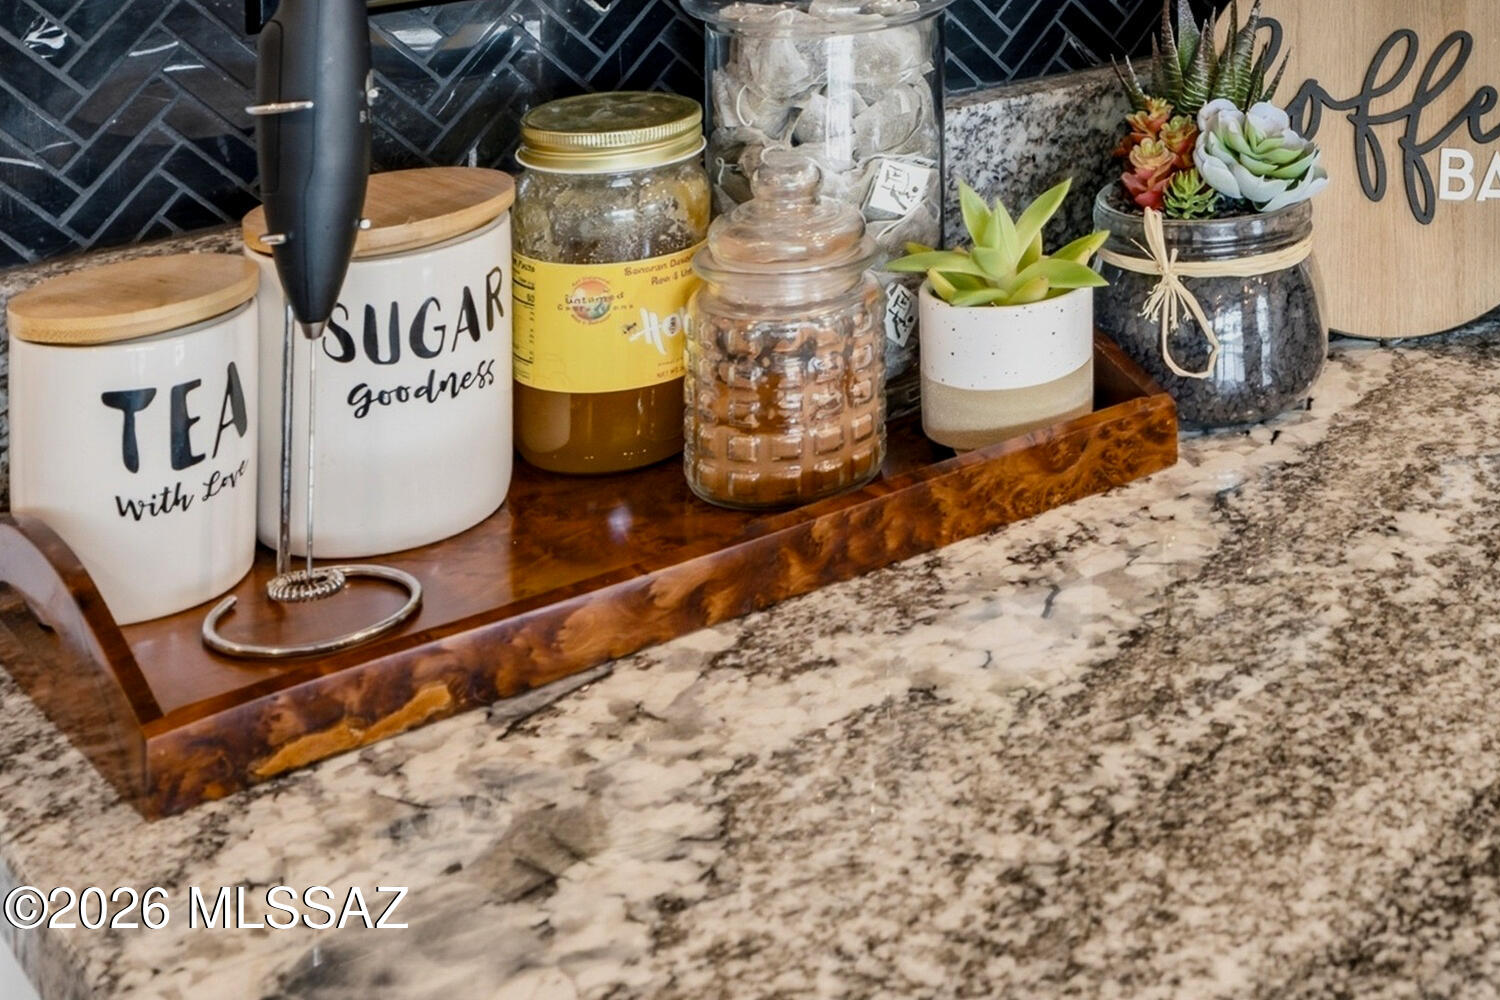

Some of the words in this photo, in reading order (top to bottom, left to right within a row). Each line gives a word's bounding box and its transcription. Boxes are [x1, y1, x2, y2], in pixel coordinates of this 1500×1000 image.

[322, 266, 504, 365] SUGAR
[101, 361, 248, 474] TEA
[202, 459, 249, 502] Love
